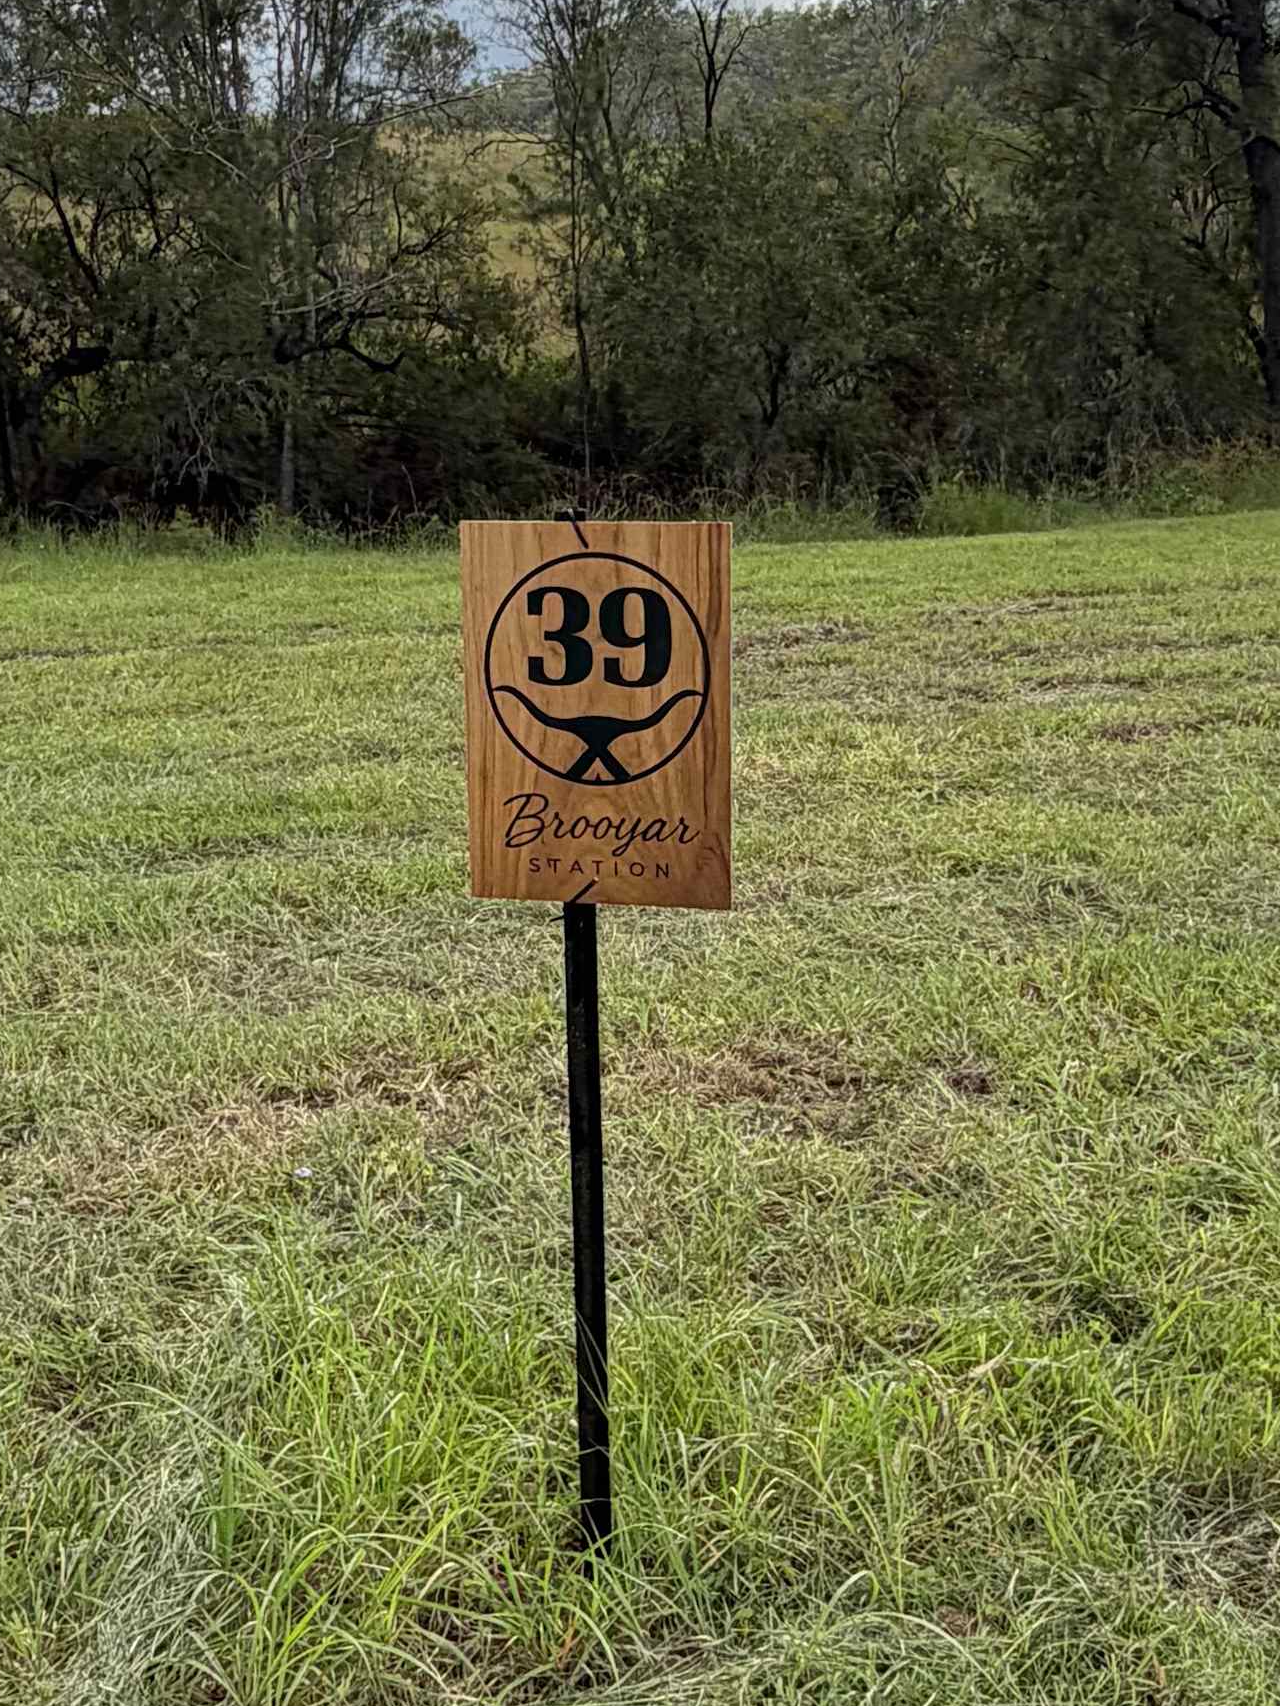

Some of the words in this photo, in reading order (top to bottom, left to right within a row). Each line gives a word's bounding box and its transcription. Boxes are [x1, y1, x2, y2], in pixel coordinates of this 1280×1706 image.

[526, 586, 673, 688] 39
[502, 793, 700, 857] Brooyar
[528, 857, 670, 879] STATION
